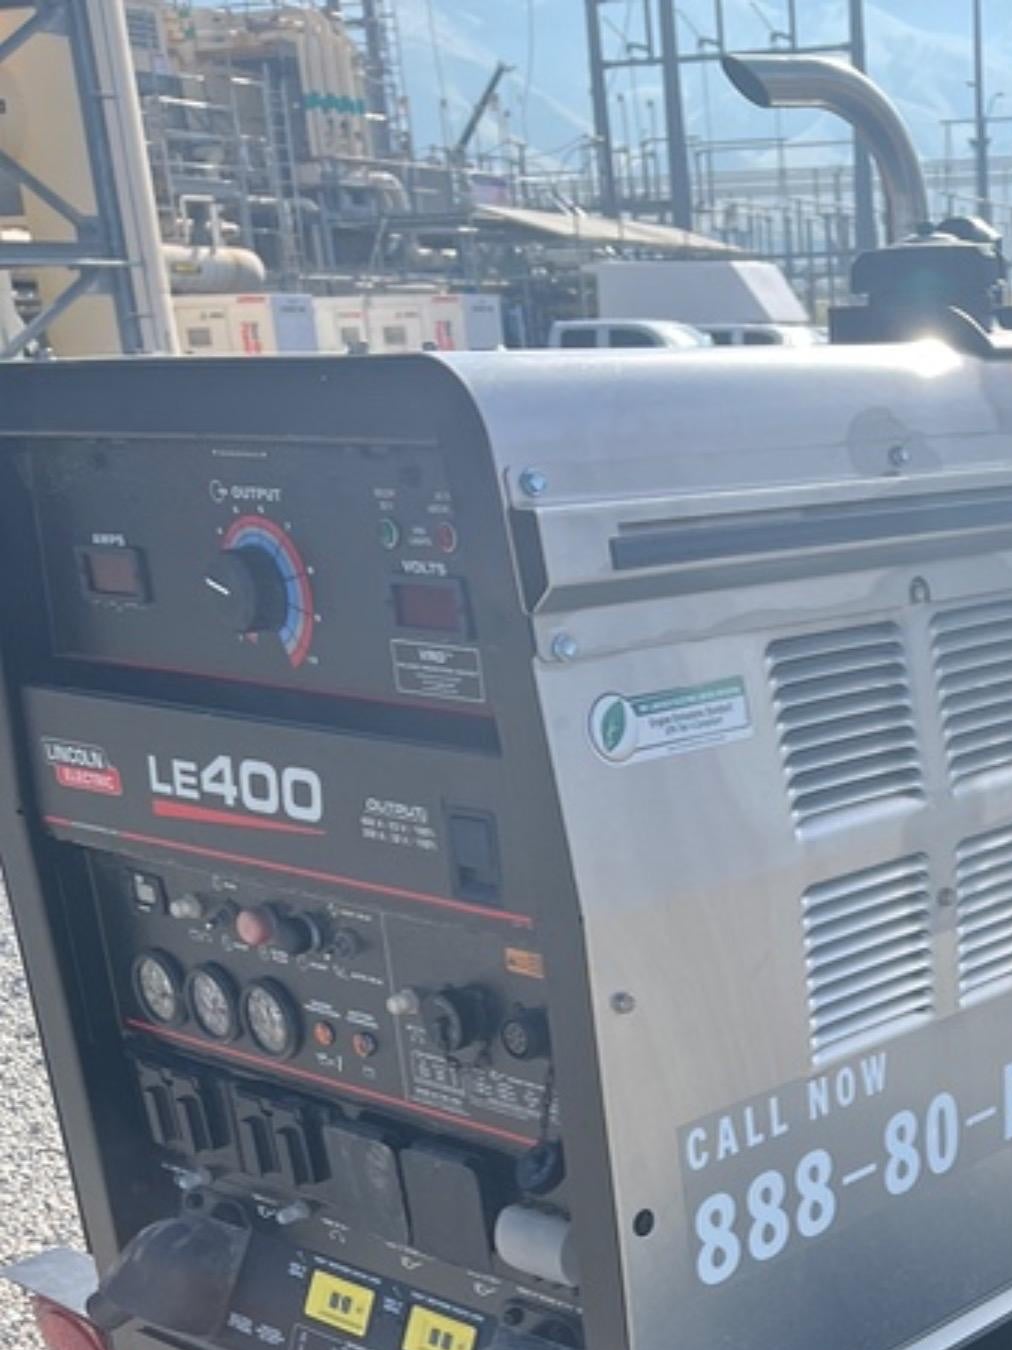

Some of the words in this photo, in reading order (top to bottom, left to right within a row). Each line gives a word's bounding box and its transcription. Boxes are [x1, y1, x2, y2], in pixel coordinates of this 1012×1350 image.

[231, 486, 281, 502] OUTPUT
[401, 560, 447, 577] VOLTS
[46, 743, 104, 768] LINCOLN
[62, 767, 115, 791] ELECTRIC
[147, 754, 322, 823] LE400
[685, 1097, 789, 1171] CALL
[808, 1051, 888, 1121] NOW
